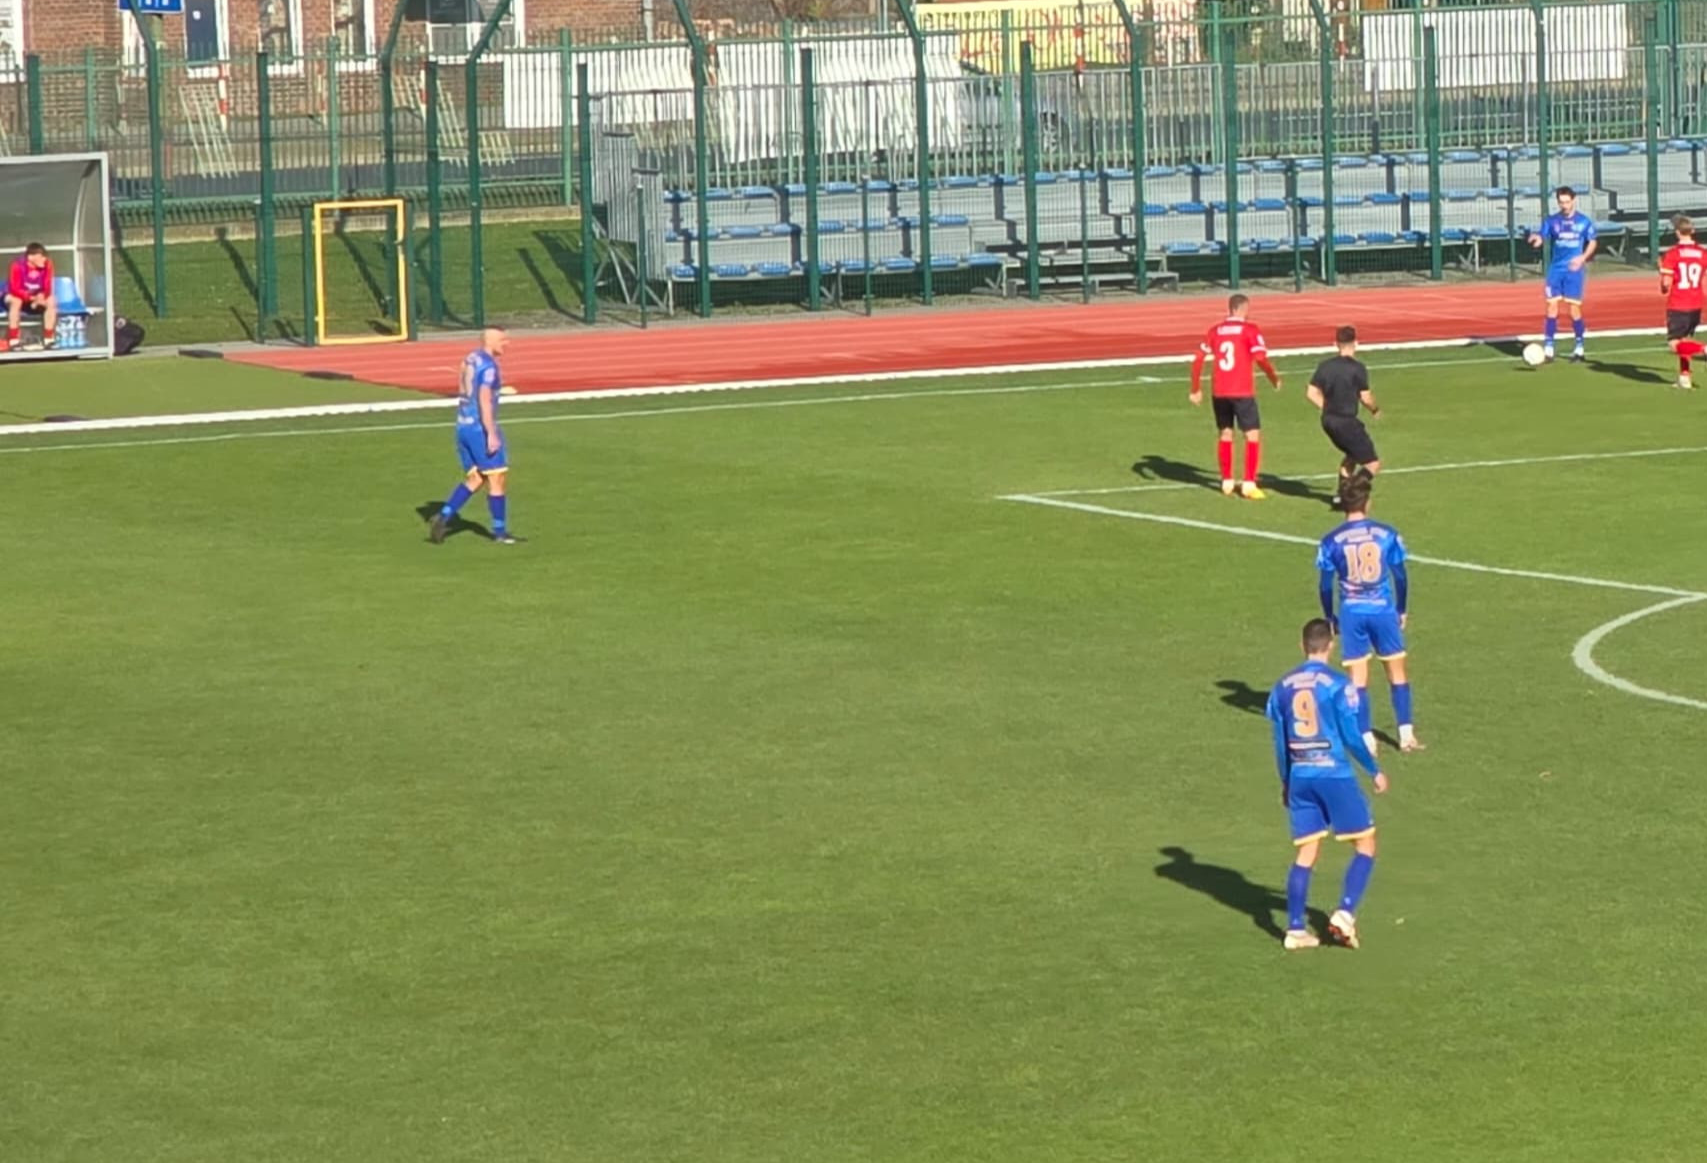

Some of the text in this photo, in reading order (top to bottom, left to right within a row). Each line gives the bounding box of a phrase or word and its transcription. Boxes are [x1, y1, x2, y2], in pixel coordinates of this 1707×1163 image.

[1678, 262, 1702, 289] 19
[1219, 341, 1235, 372] 3
[1343, 541, 1382, 584] 18
[1292, 689, 1319, 738] 9
